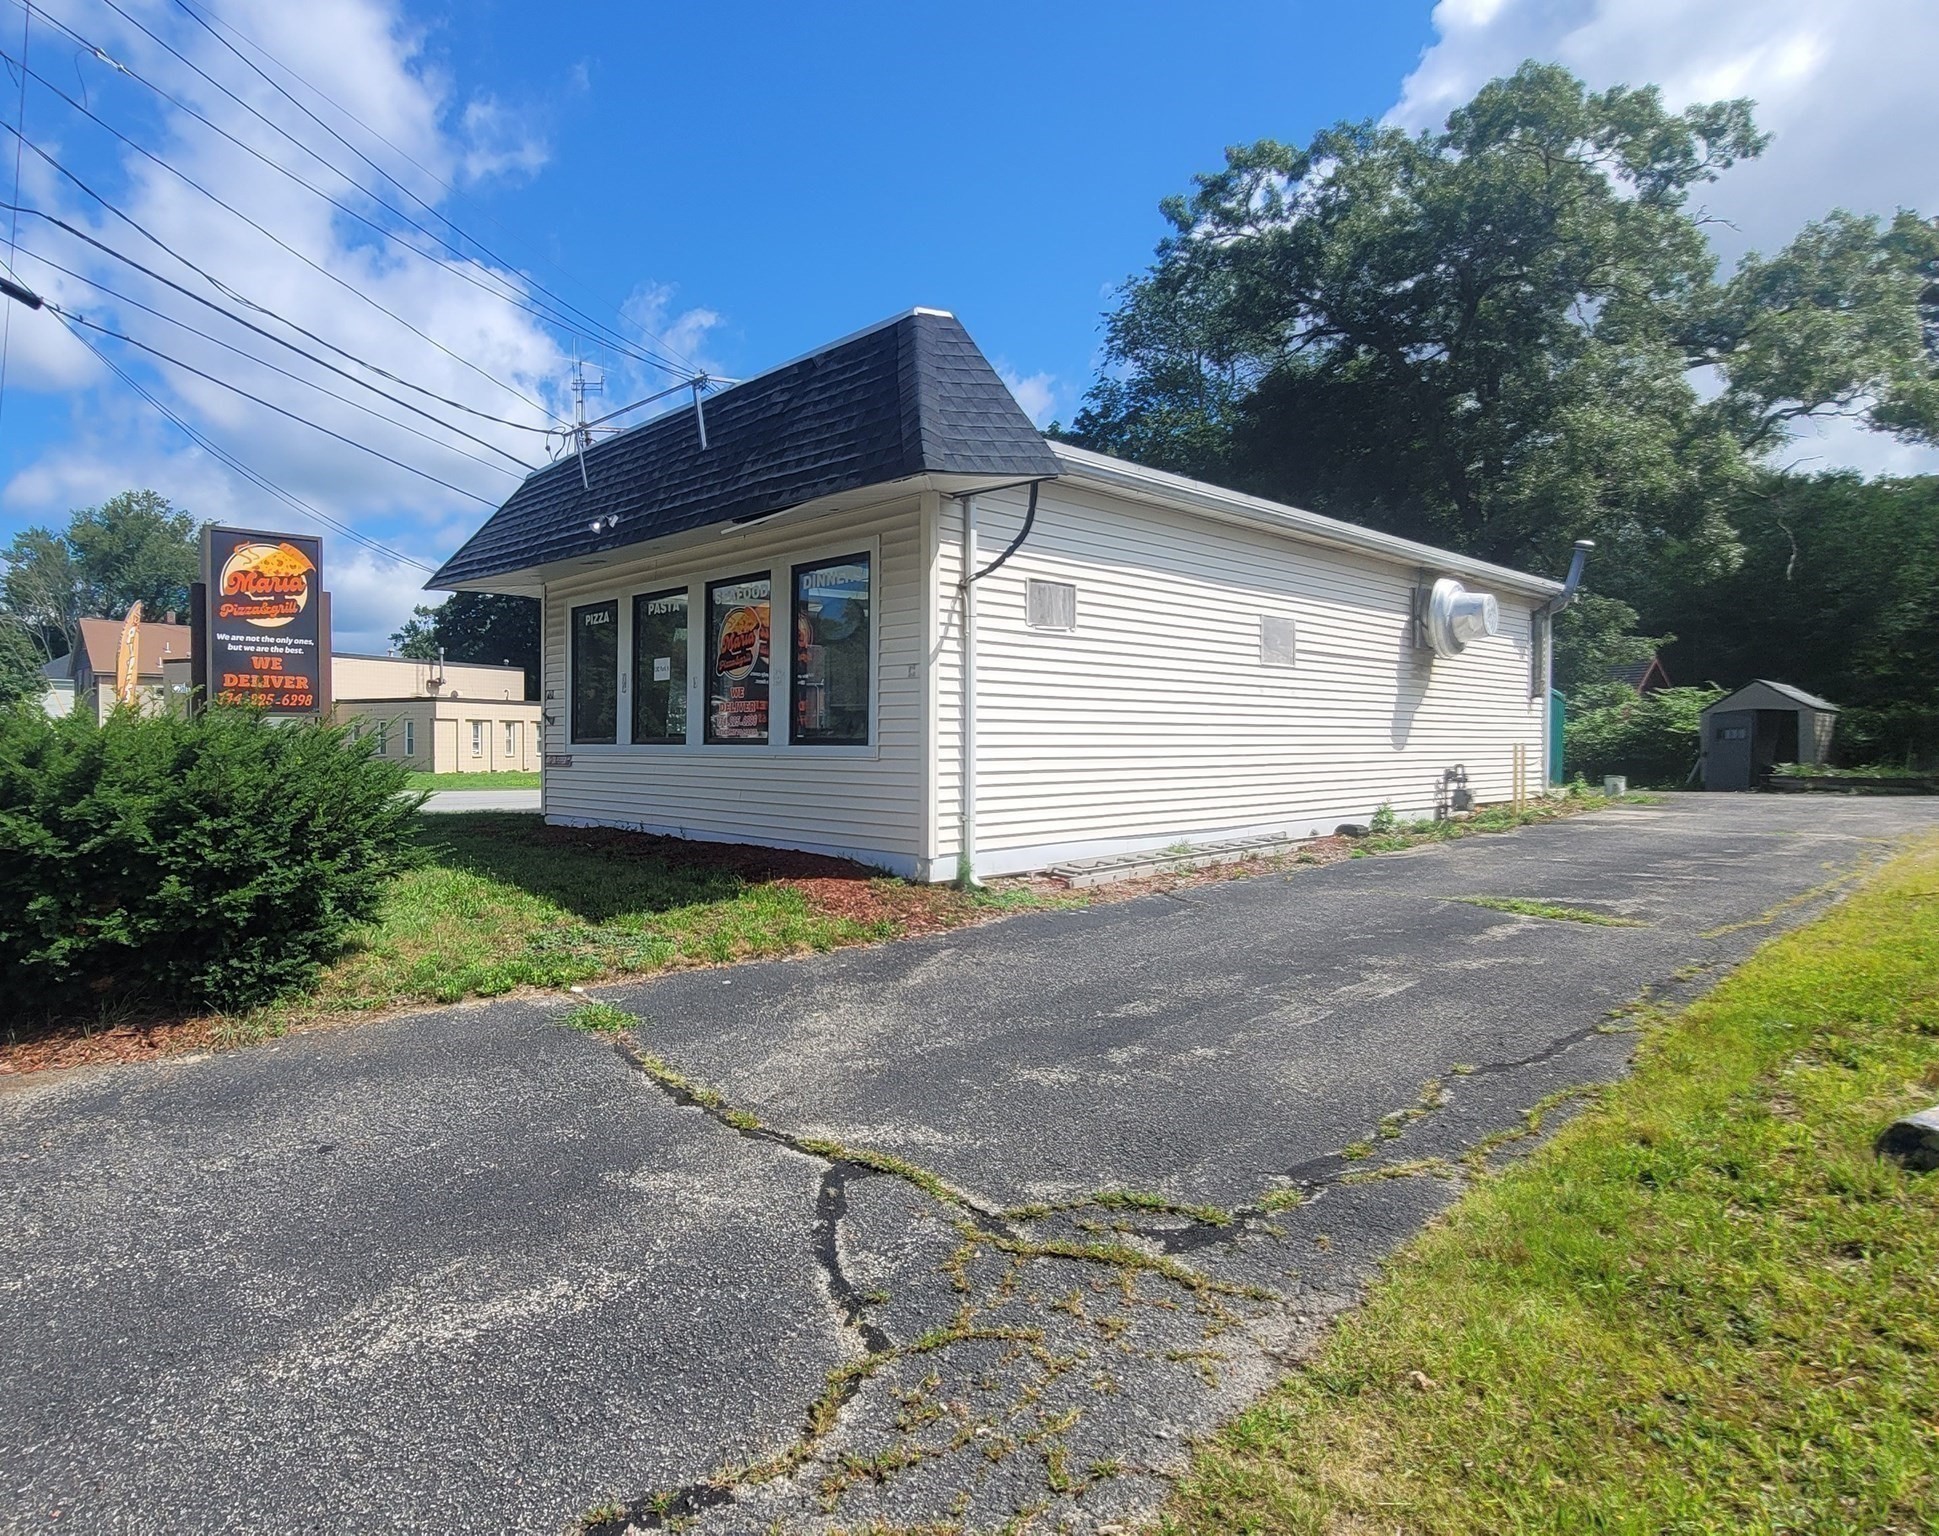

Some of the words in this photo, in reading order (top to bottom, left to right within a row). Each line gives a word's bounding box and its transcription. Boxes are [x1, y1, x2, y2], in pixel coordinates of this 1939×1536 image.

[224, 571, 307, 596] Maria
[648, 602, 680, 616] PASTA
[585, 611, 610, 627] PIZZA
[216, 633, 230, 641] We
[230, 634, 244, 642] are
[245, 634, 260, 642] not
[261, 635, 275, 643] the
[275, 636, 294, 646] only
[293, 638, 314, 646] ones,
[227, 643, 243, 651] but
[270, 645, 284, 654] the
[284, 646, 305, 654] best.
[251, 656, 283, 671] WE
[223, 673, 309, 689] DELIVER
[730, 686, 745, 699] WE
[719, 701, 757, 713] DELIVER
